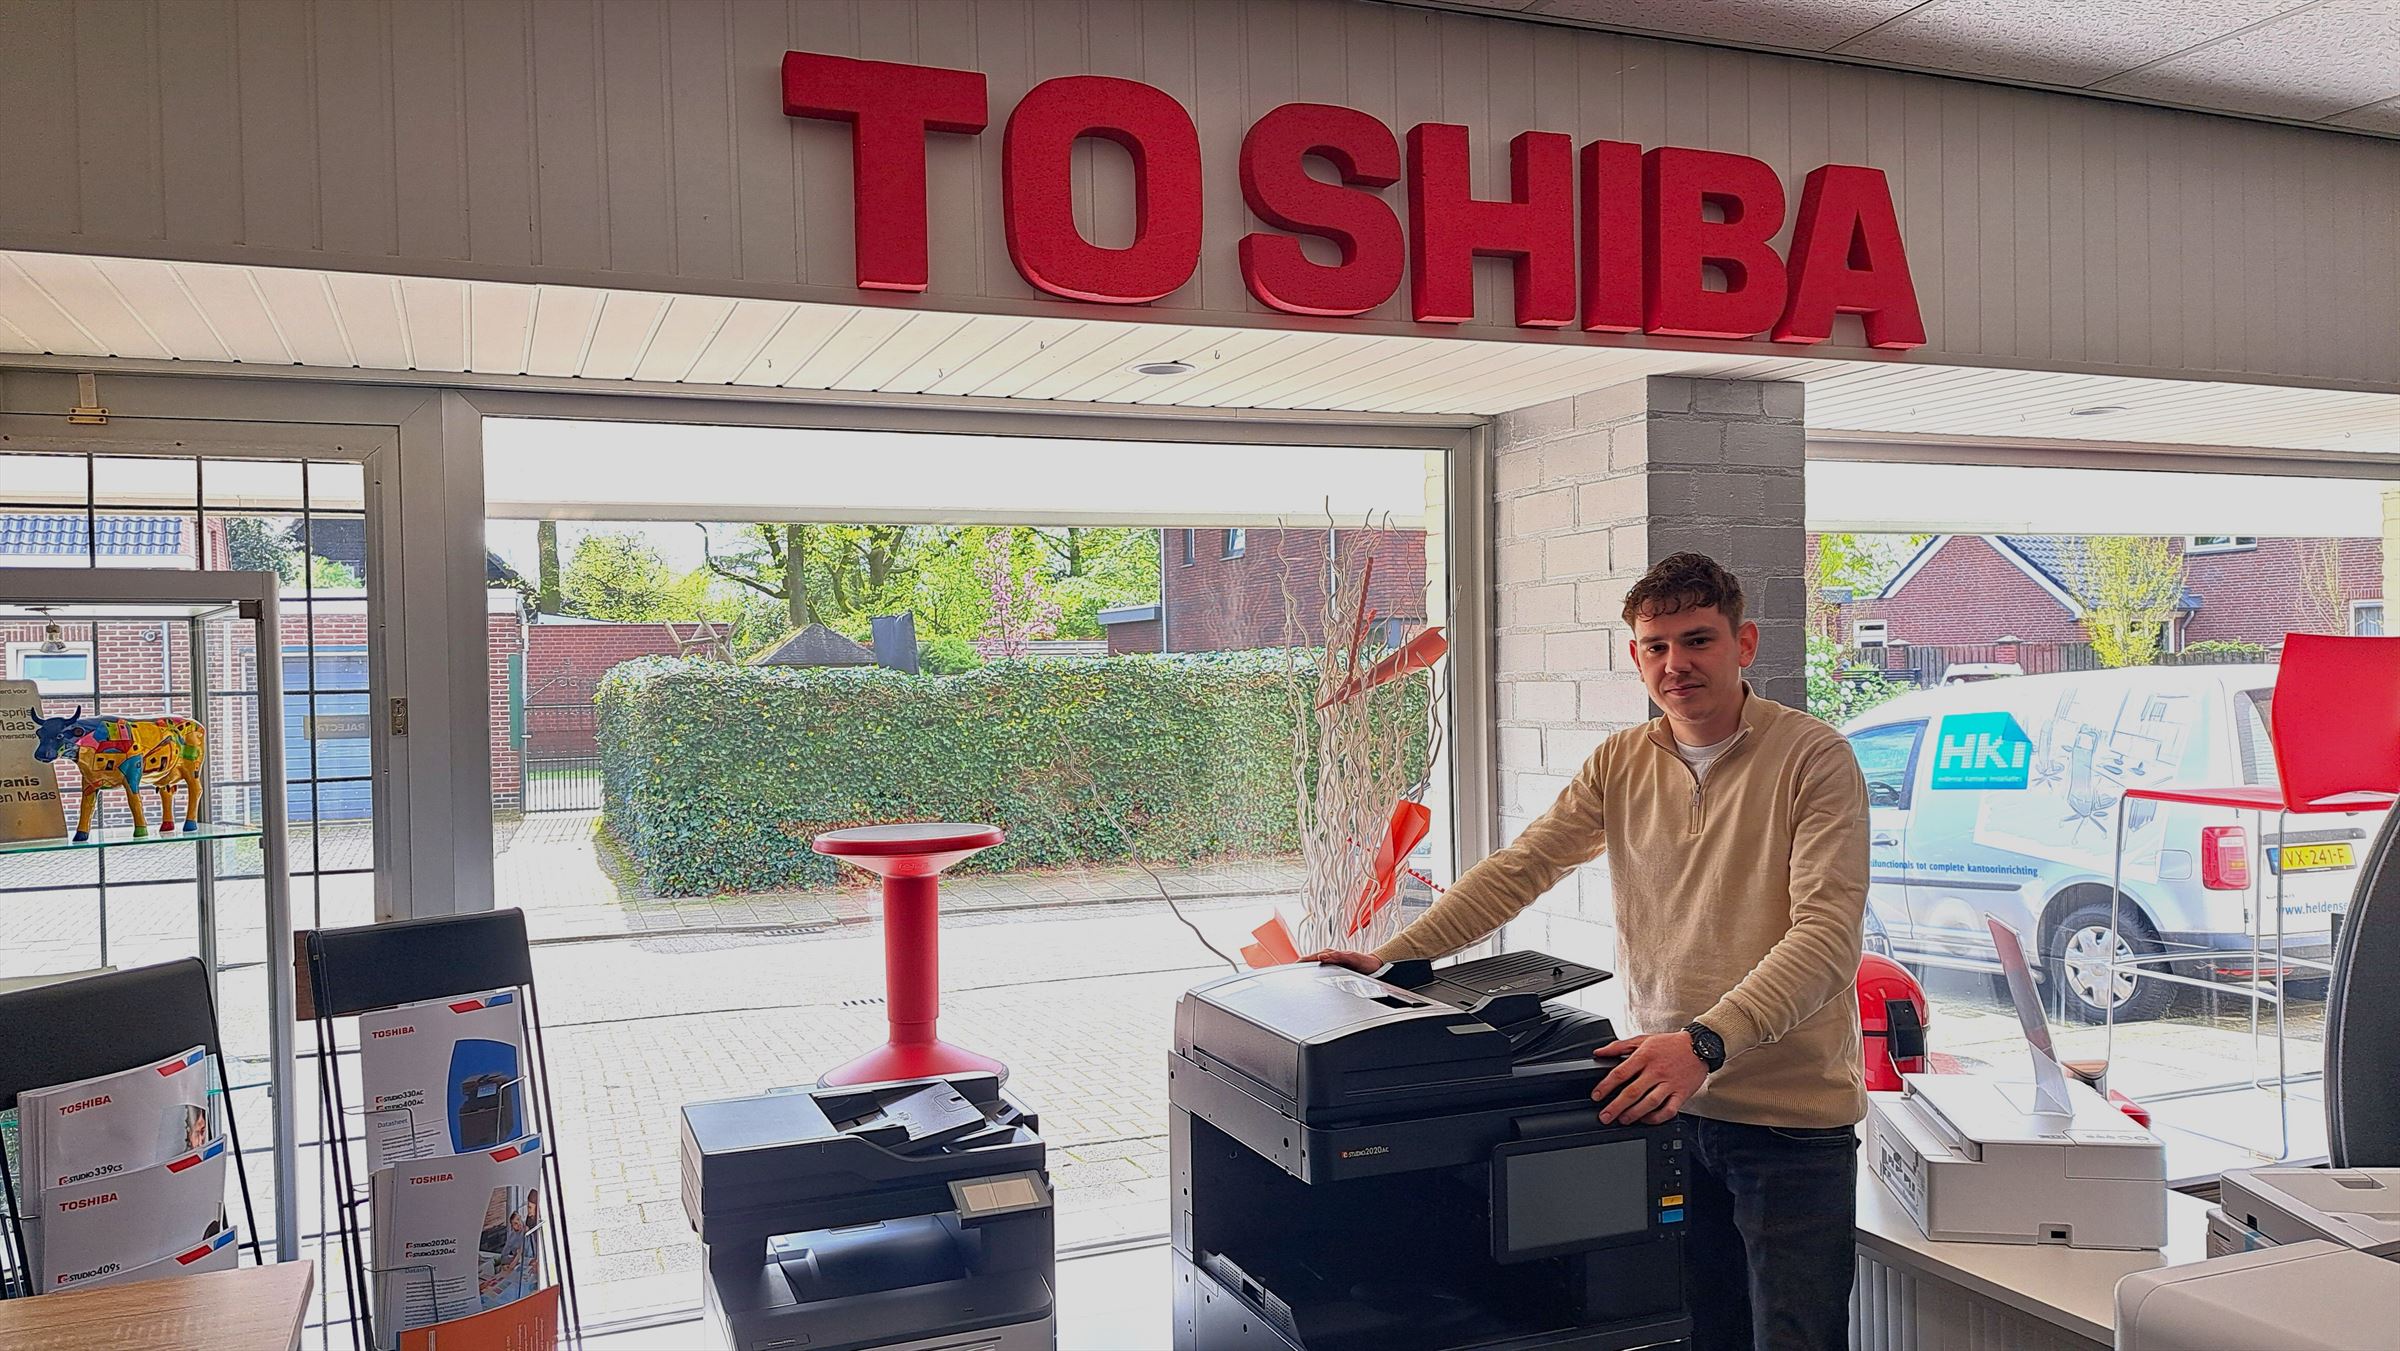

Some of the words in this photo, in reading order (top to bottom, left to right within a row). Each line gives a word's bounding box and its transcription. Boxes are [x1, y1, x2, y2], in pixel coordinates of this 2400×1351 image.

[782, 51, 1927, 350] TOSHIBA
[1939, 732, 2027, 769] HKI
[17, 790, 57, 802] Maas
[2285, 848, 2344, 865] VX-241-F
[1916, 862, 1927, 870] tot
[1929, 862, 1965, 874] complete
[1967, 865, 2039, 878] kantoorinrichting
[371, 1026, 415, 1039] TOSHIBA
[59, 1095, 112, 1116] TOSHIBA
[409, 1173, 454, 1185] TOSHIBA
[59, 1192, 119, 1212] TOSHIBA
